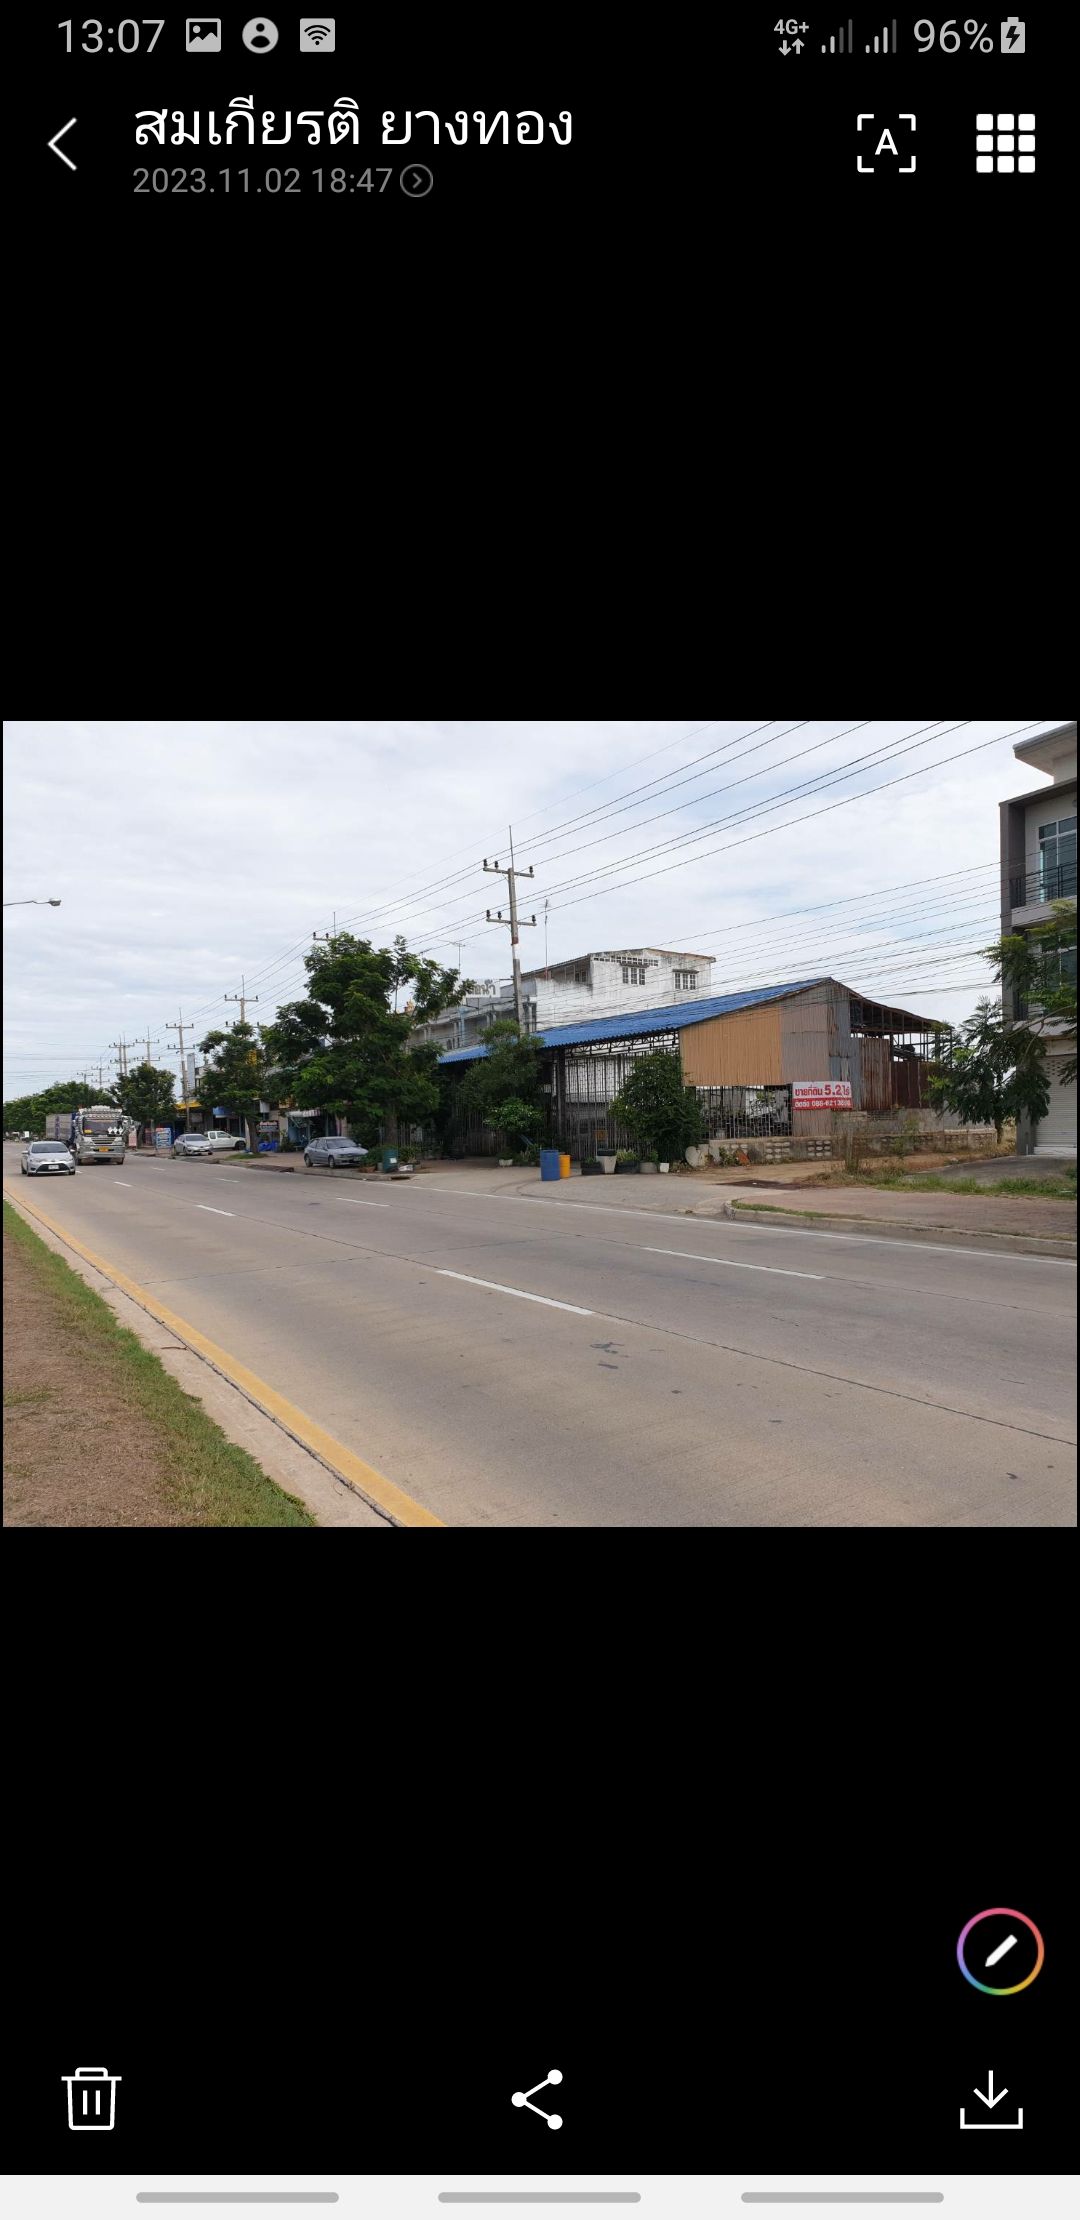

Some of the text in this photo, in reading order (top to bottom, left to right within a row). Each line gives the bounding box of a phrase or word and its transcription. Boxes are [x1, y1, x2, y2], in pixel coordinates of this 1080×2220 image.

[795, 1084, 822, 1096] ขายที่ดิน
[824, 1084, 841, 1096] 5.2
